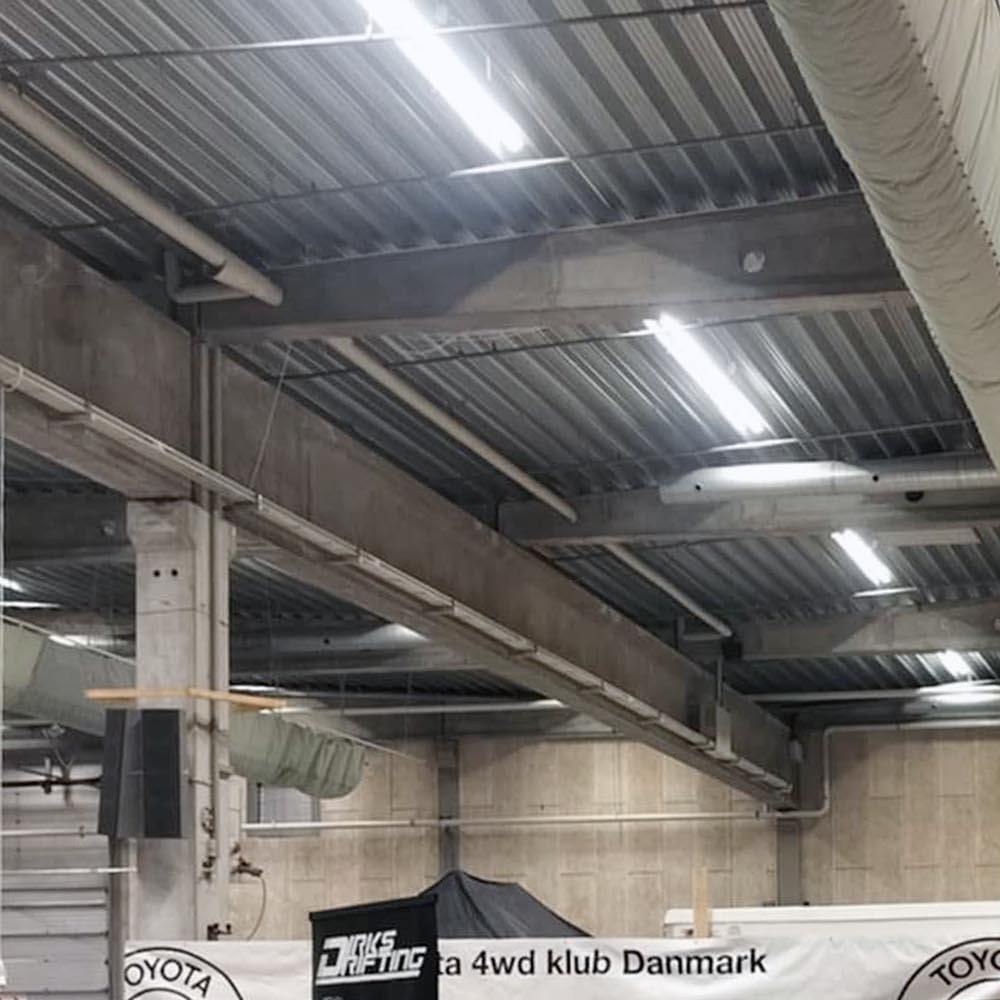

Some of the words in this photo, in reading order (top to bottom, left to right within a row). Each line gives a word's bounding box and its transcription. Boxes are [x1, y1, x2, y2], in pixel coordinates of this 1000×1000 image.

[123, 958, 212, 998] OYOTA
[471, 950, 535, 975] 4wd
[547, 949, 611, 975] klub
[622, 948, 767, 975] Danmark
